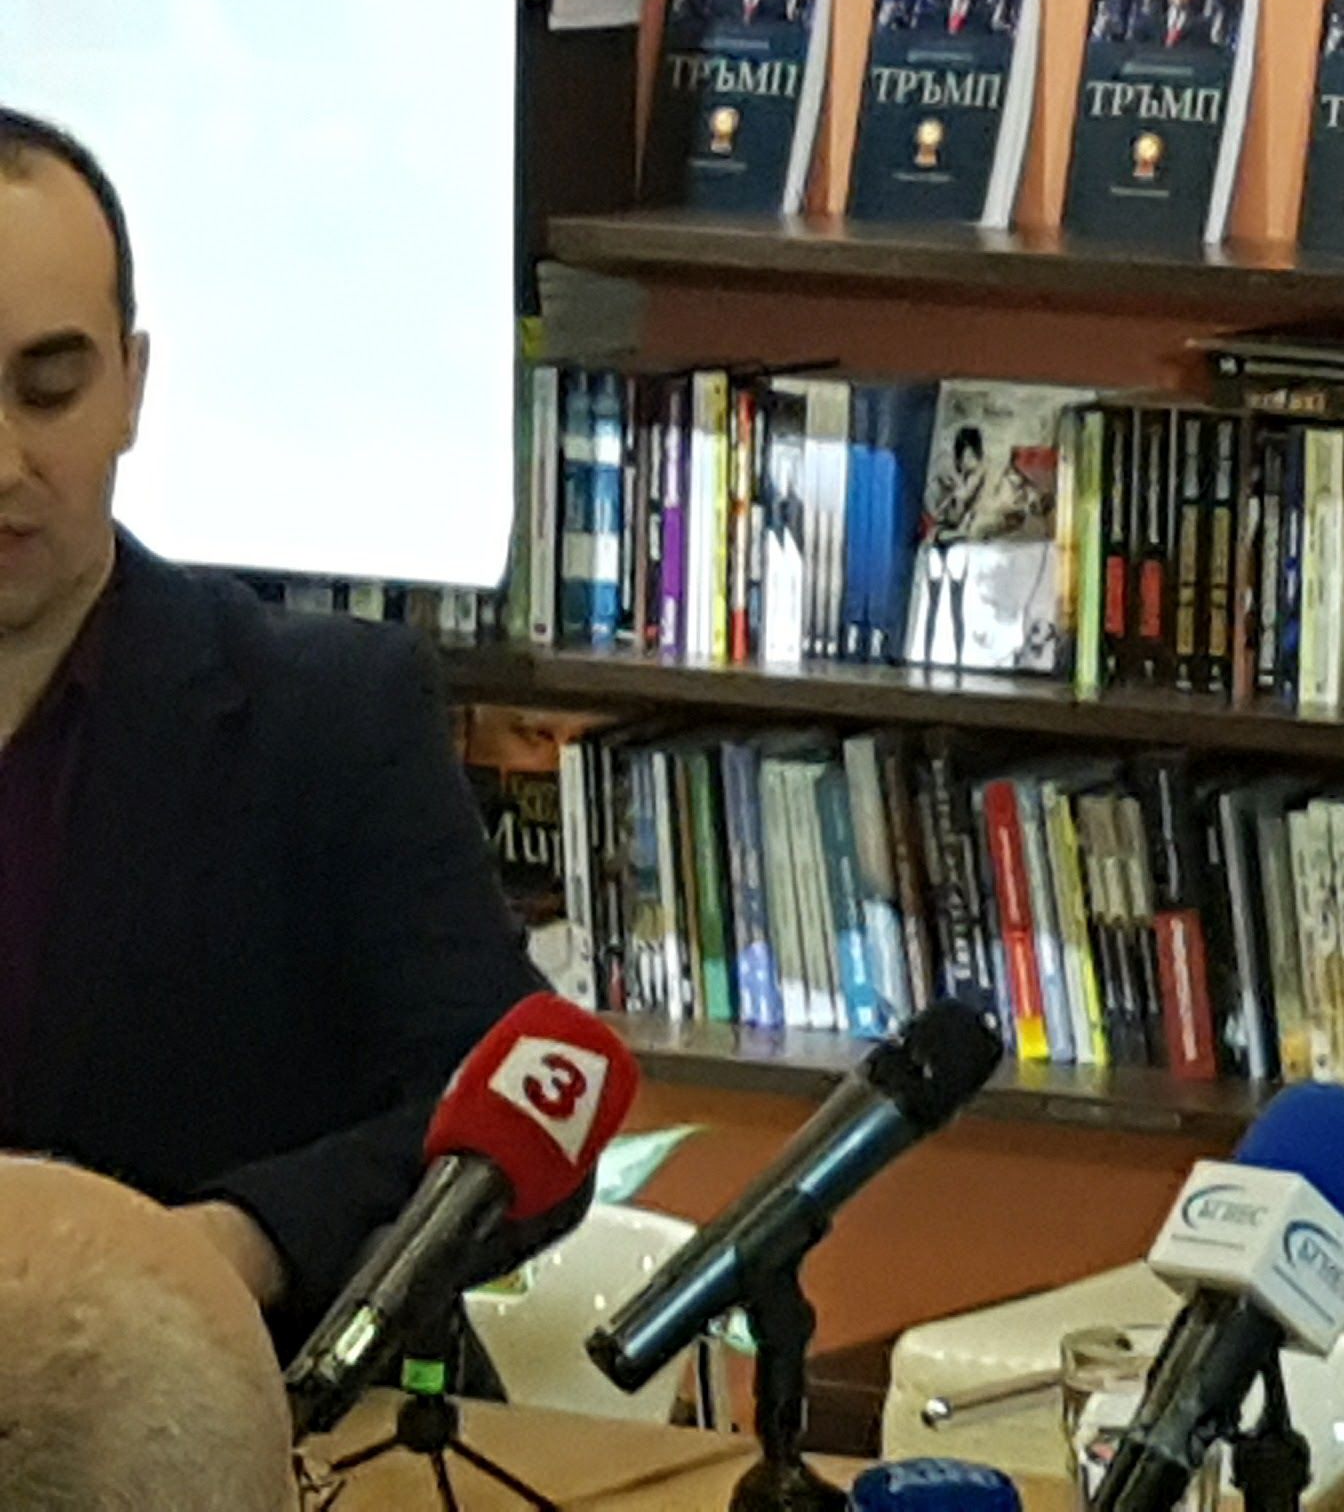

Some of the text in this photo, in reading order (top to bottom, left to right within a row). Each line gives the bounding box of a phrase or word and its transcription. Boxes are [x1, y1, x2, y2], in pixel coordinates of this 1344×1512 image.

[667, 54, 798, 99] ТРЪМП
[871, 66, 1002, 109] ТРЪМП
[1086, 79, 1224, 124] ТРЪМП
[523, 1052, 588, 1121] 3
